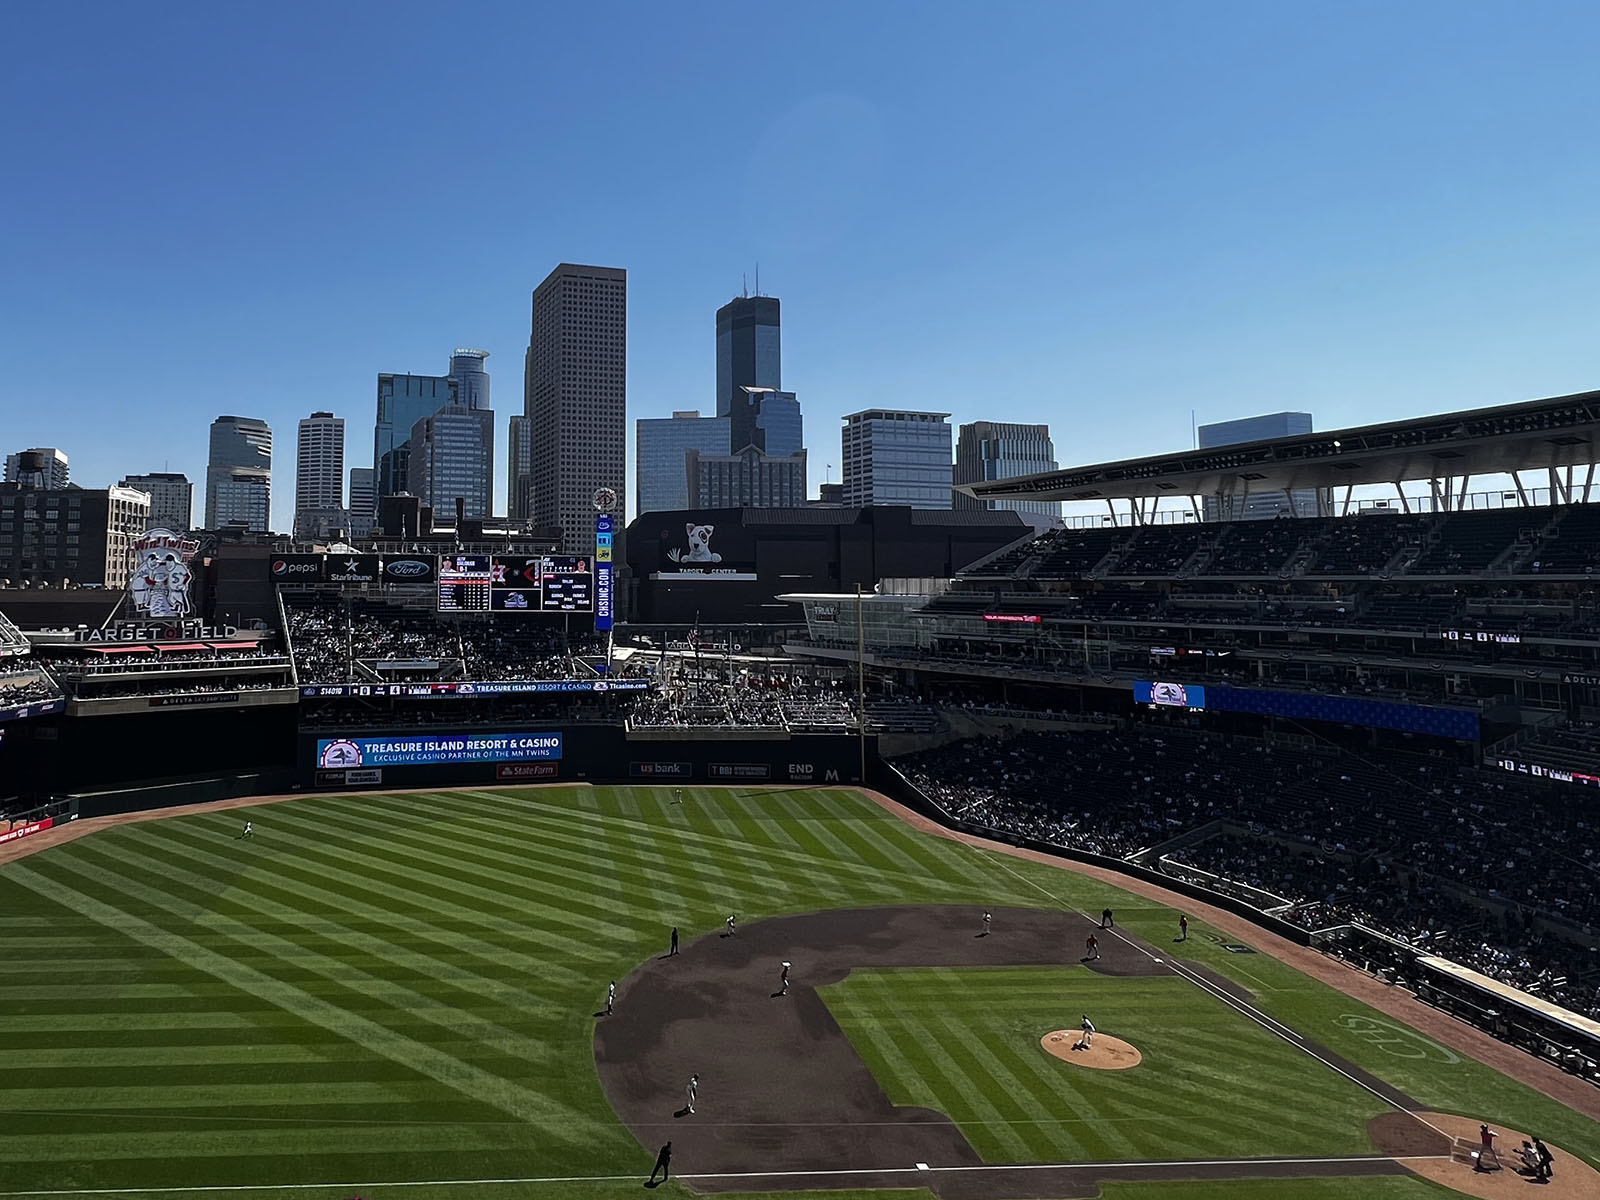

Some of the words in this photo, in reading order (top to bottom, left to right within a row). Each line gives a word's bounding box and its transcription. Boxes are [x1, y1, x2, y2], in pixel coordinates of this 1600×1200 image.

[134, 536, 160, 551] Win!
[161, 535, 200, 552] Twins!
[288, 563, 318, 574] pepsi
[394, 563, 421, 574] Ford
[171, 572, 180, 584] S
[330, 573, 373, 581] StarTribune
[598, 568, 609, 617] CHSINC.COM
[77, 628, 161, 641] TARGET
[182, 626, 237, 639] FIELD
[364, 742, 422, 753] TREASURE
[425, 741, 464, 751] ISLAND
[466, 740, 508, 750] RESORT
[510, 739, 517, 748] &
[519, 738, 559, 748] CASINO
[374, 753, 414, 762] EXCLUSIVE
[416, 752, 446, 760] CASINO
[448, 752, 481, 760] PARTNER
[654, 763, 680, 773] bank
[788, 763, 814, 774] END
[824, 768, 840, 782] M
